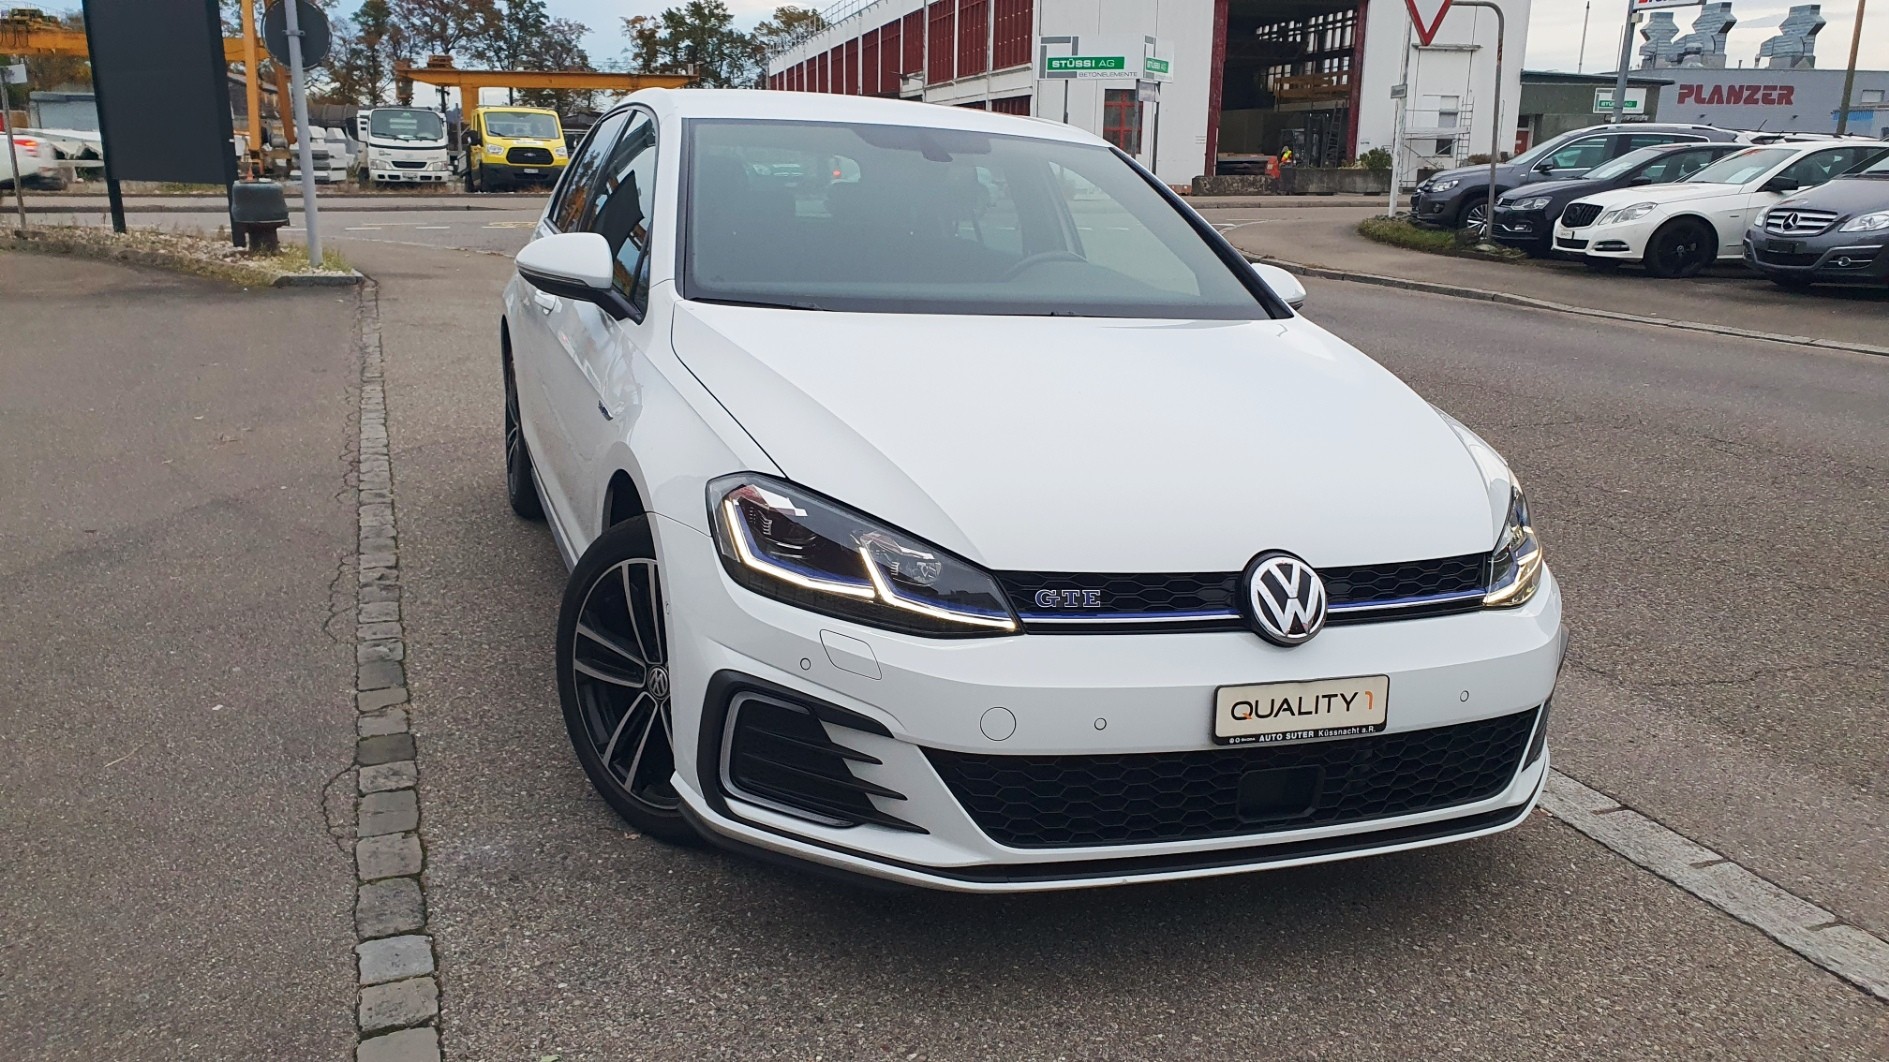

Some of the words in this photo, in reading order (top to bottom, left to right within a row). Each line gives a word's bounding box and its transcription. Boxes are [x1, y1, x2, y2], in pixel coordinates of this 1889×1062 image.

[1052, 58, 1095, 68] STÜSSI
[1098, 59, 1115, 68] AG
[1677, 84, 1795, 105] PLANZER
[1034, 589, 1101, 608] GTE
[1230, 692, 1359, 720] QUALITY
[1259, 733, 1283, 742] AUTO
[1285, 731, 1314, 740] SUTER
[1318, 727, 1360, 737] Küssnacht
